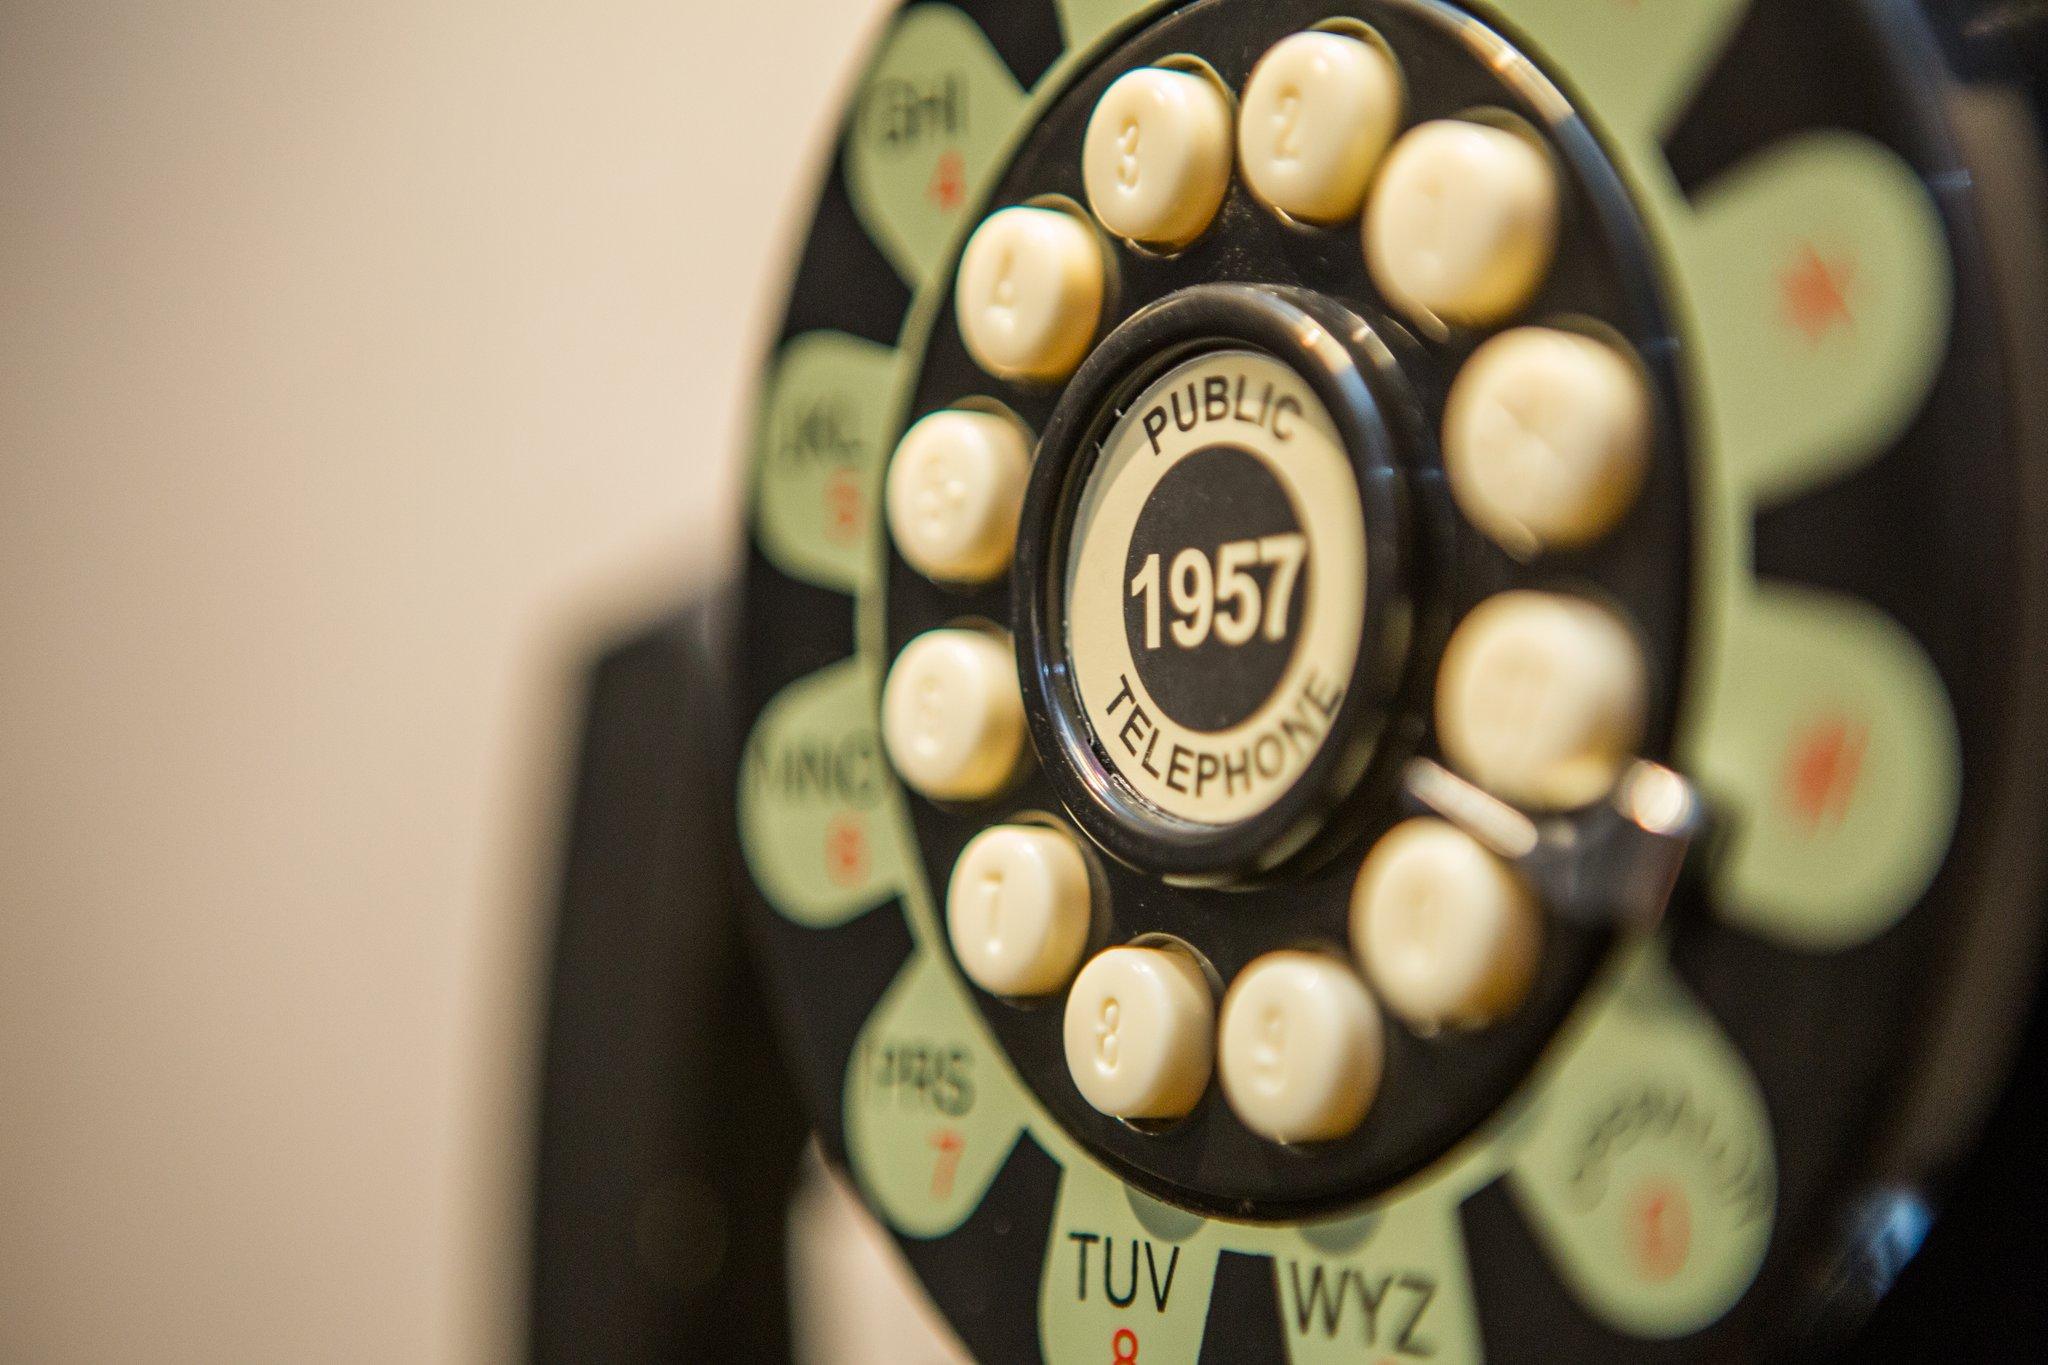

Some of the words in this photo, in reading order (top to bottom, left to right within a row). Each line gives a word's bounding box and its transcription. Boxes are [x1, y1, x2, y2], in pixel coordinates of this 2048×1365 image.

[1142, 374, 1304, 456] PUBLIC
[1130, 530, 1308, 650] 1957
[1106, 668, 1348, 799] TELEPHONE
[1092, 995, 1122, 1079] 8
[1068, 1231, 1181, 1314] TUV
[1290, 1260, 1438, 1357] WYZ
